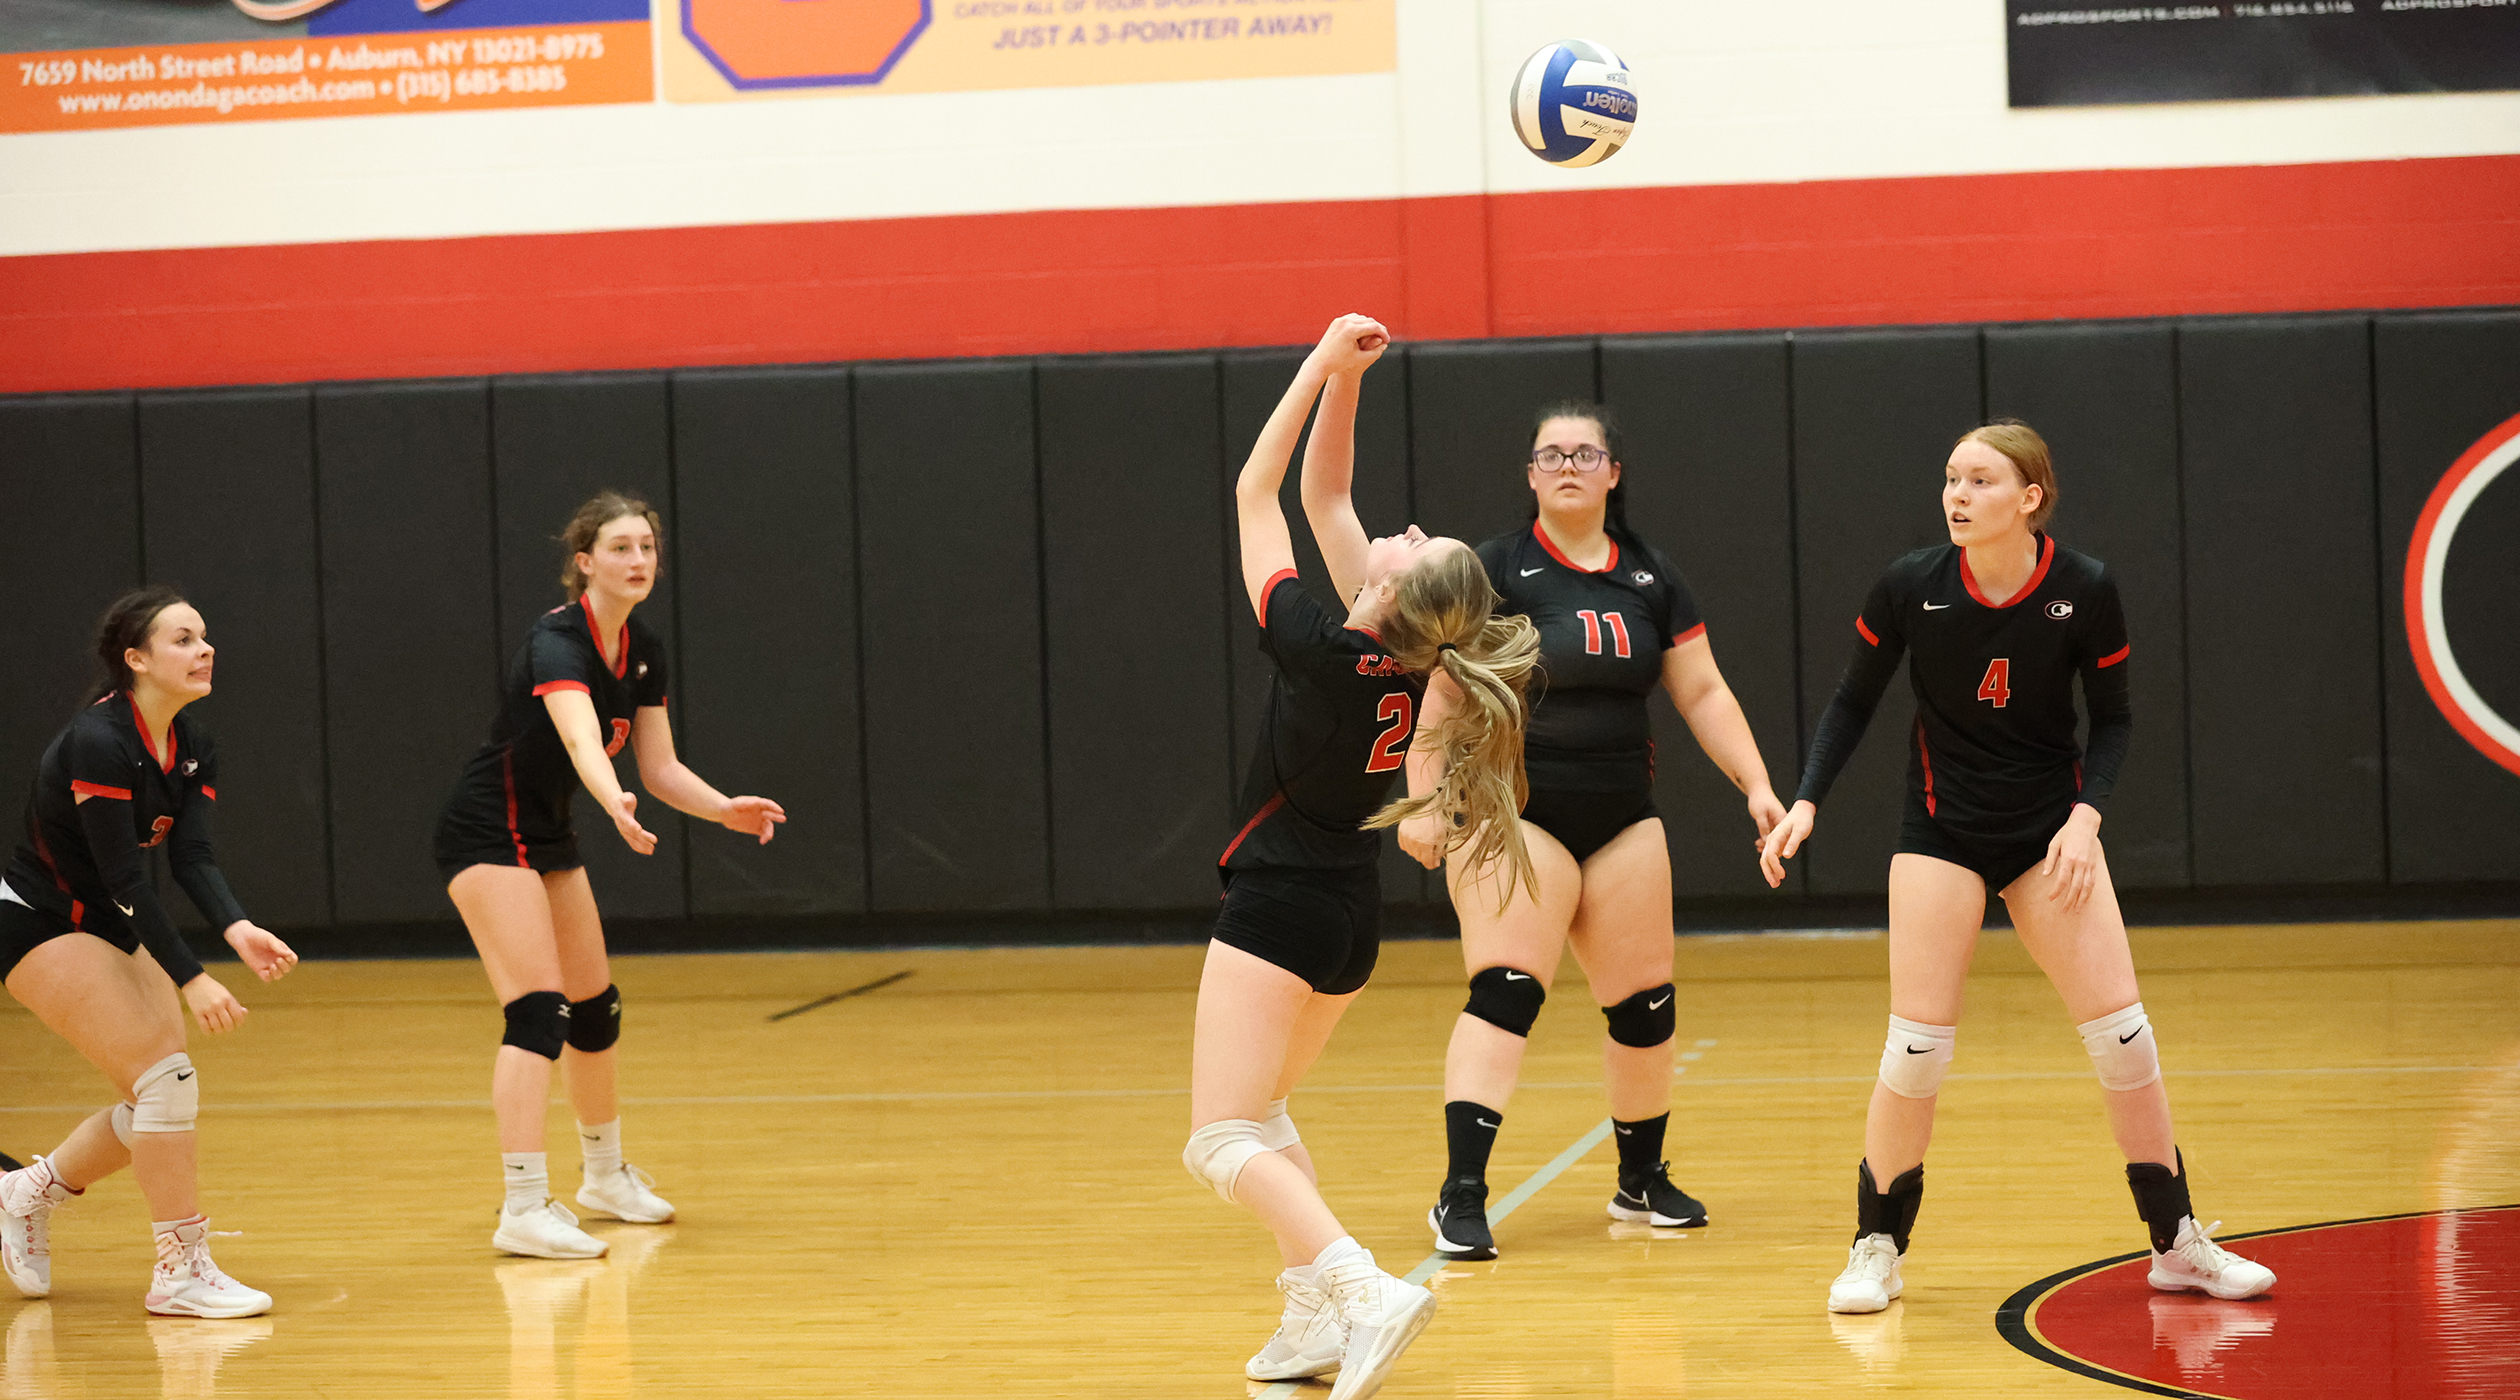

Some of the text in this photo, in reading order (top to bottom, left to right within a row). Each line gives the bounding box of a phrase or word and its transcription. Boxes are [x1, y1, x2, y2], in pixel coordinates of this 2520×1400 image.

[952, 2, 1018, 19] CATCH
[993, 25, 1062, 50] JUST
[1068, 24, 1087, 46] A
[1094, 16, 1239, 46] 3-POINTER
[19, 32, 605, 86] 7659 North Street Road Auburn, NY 13021-8975
[58, 76, 376, 114] www.onondagacoach.com
[396, 69, 451, 105] (315)
[1576, 609, 1631, 658] 11
[1977, 658, 2011, 708] 4
[1365, 691, 1412, 773] 2
